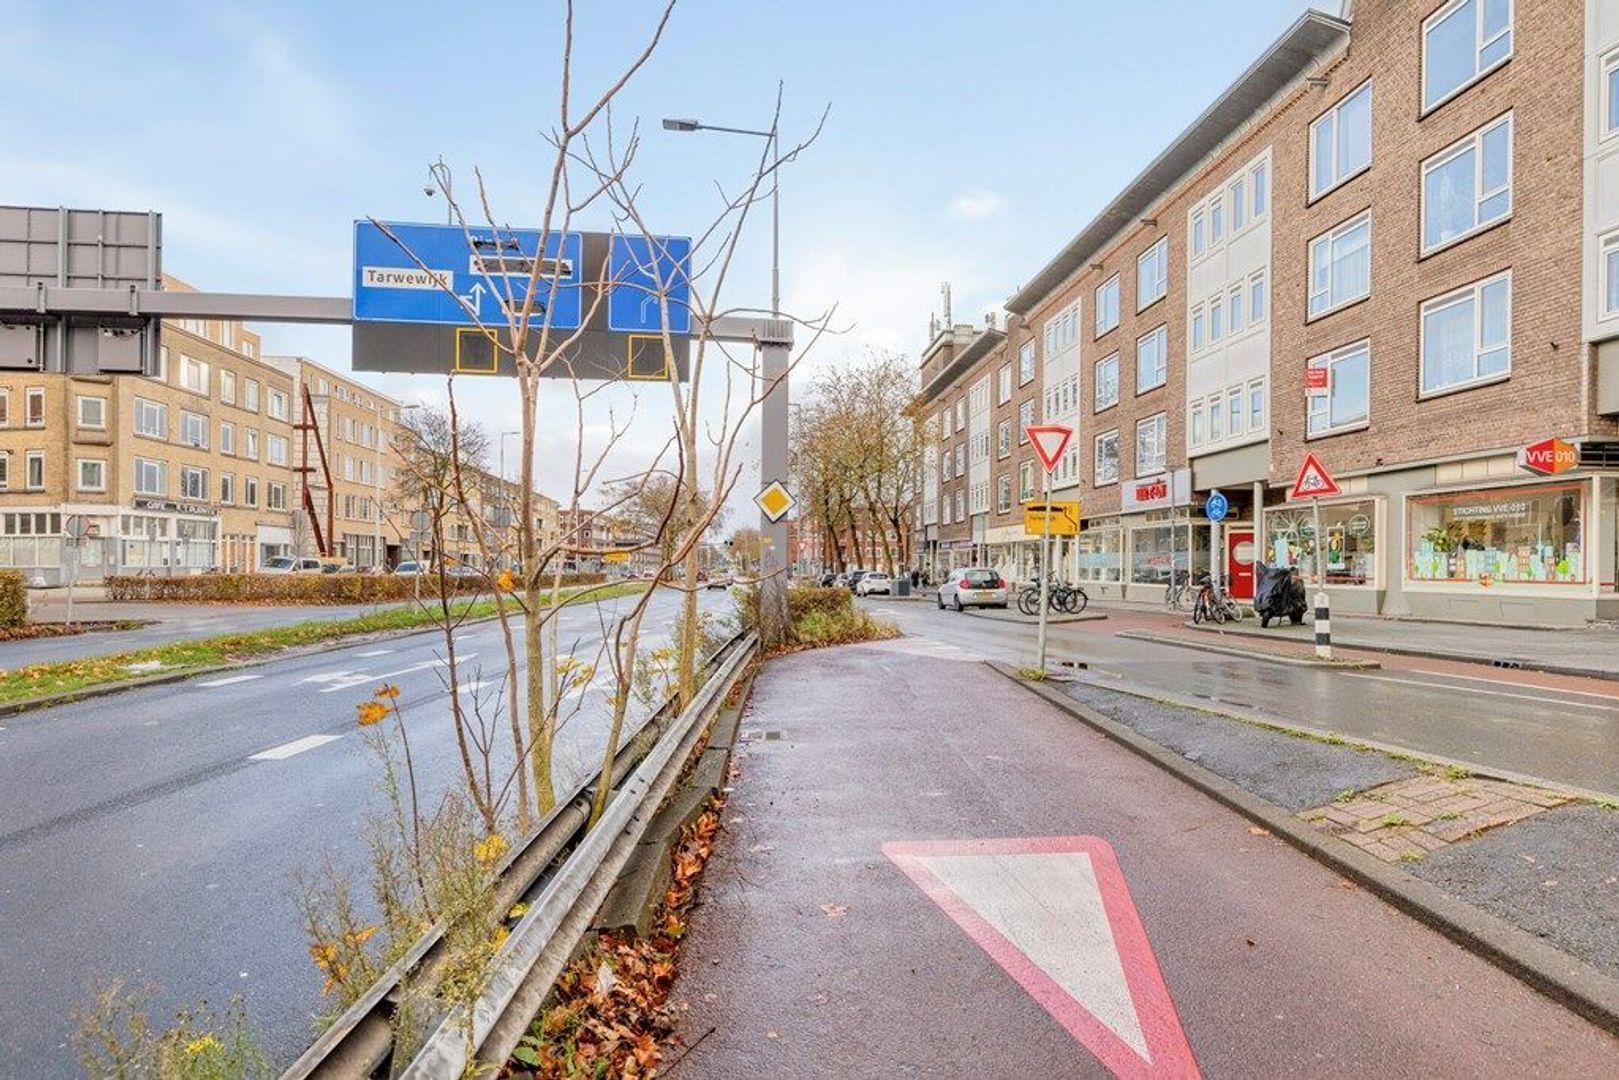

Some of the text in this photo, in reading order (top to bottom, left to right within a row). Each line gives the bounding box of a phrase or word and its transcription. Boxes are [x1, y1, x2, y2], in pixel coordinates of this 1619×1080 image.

[367, 270, 448, 287] Tarwewijk
[1525, 450, 1575, 463] VVE 010
[1453, 505, 1492, 516] STICHTING
